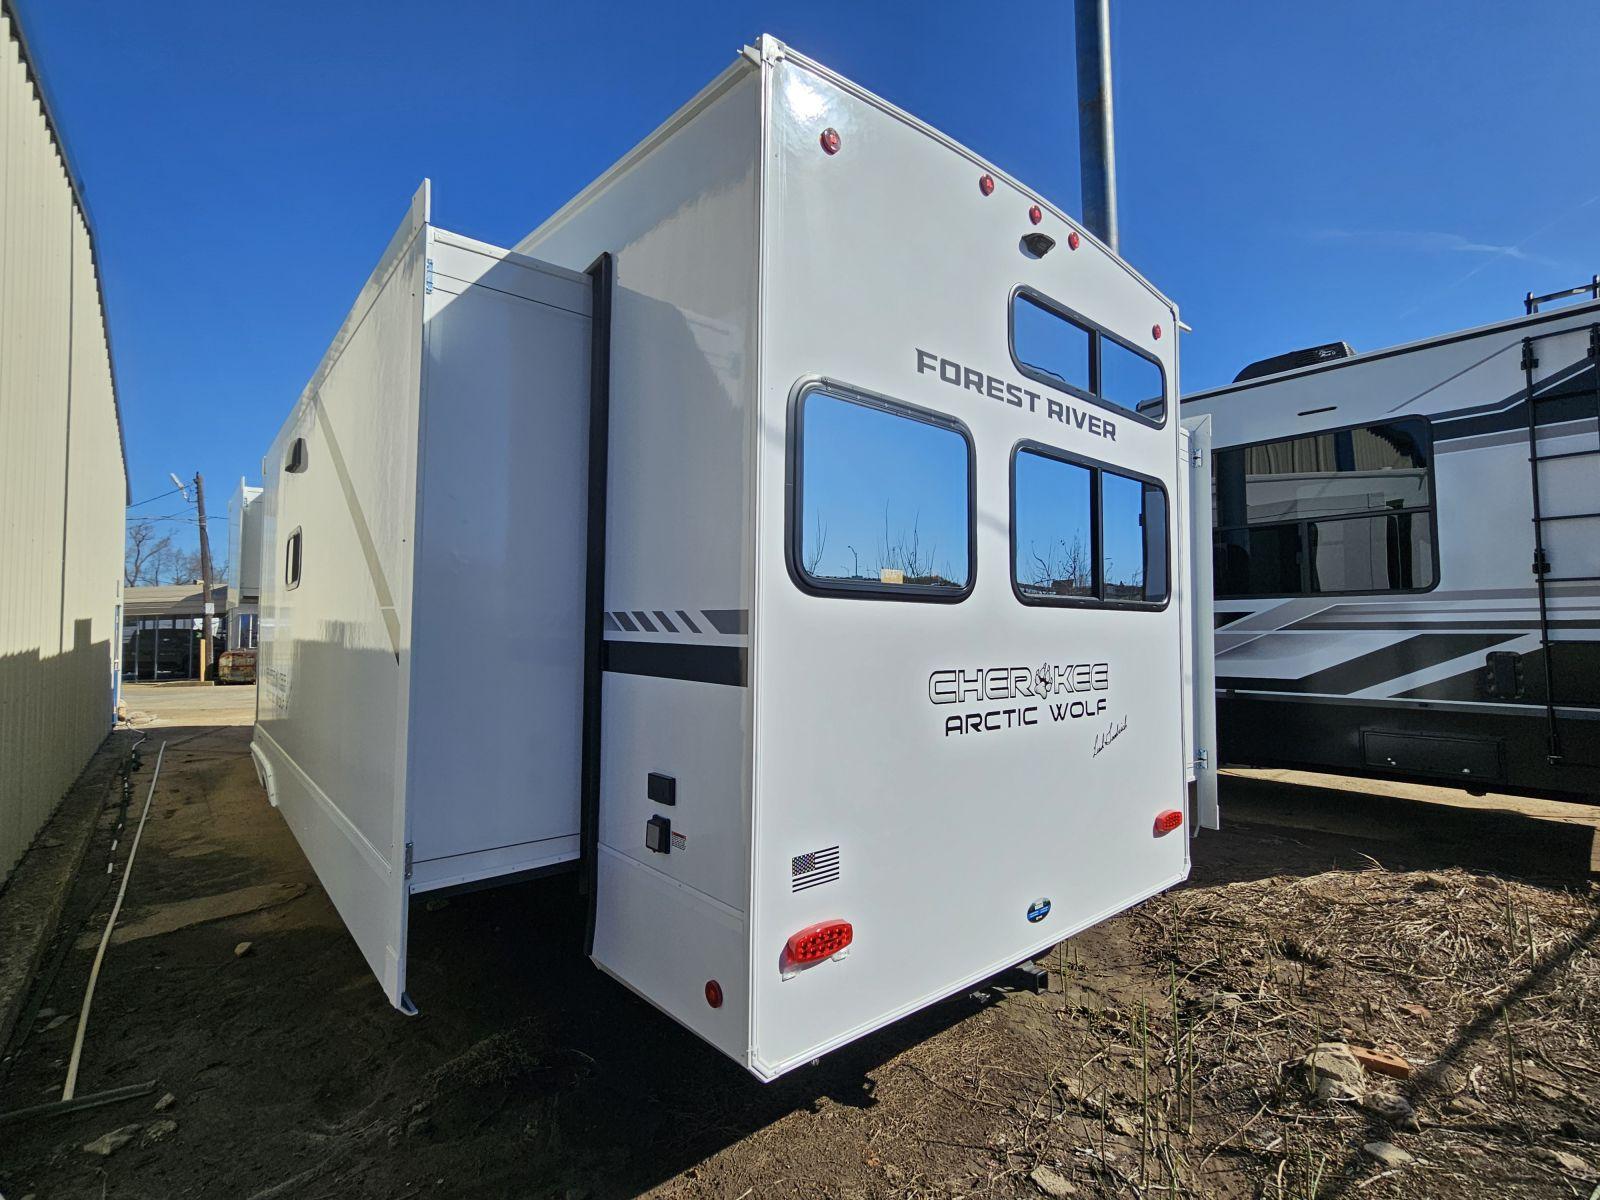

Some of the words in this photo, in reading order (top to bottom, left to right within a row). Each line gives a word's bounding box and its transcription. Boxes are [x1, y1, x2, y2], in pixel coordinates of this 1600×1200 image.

[915, 347, 1041, 413] FOREST
[1046, 397, 1117, 442] RIVER
[945, 706, 1038, 737] ARCTIC
[1049, 698, 1107, 722] WOLF
